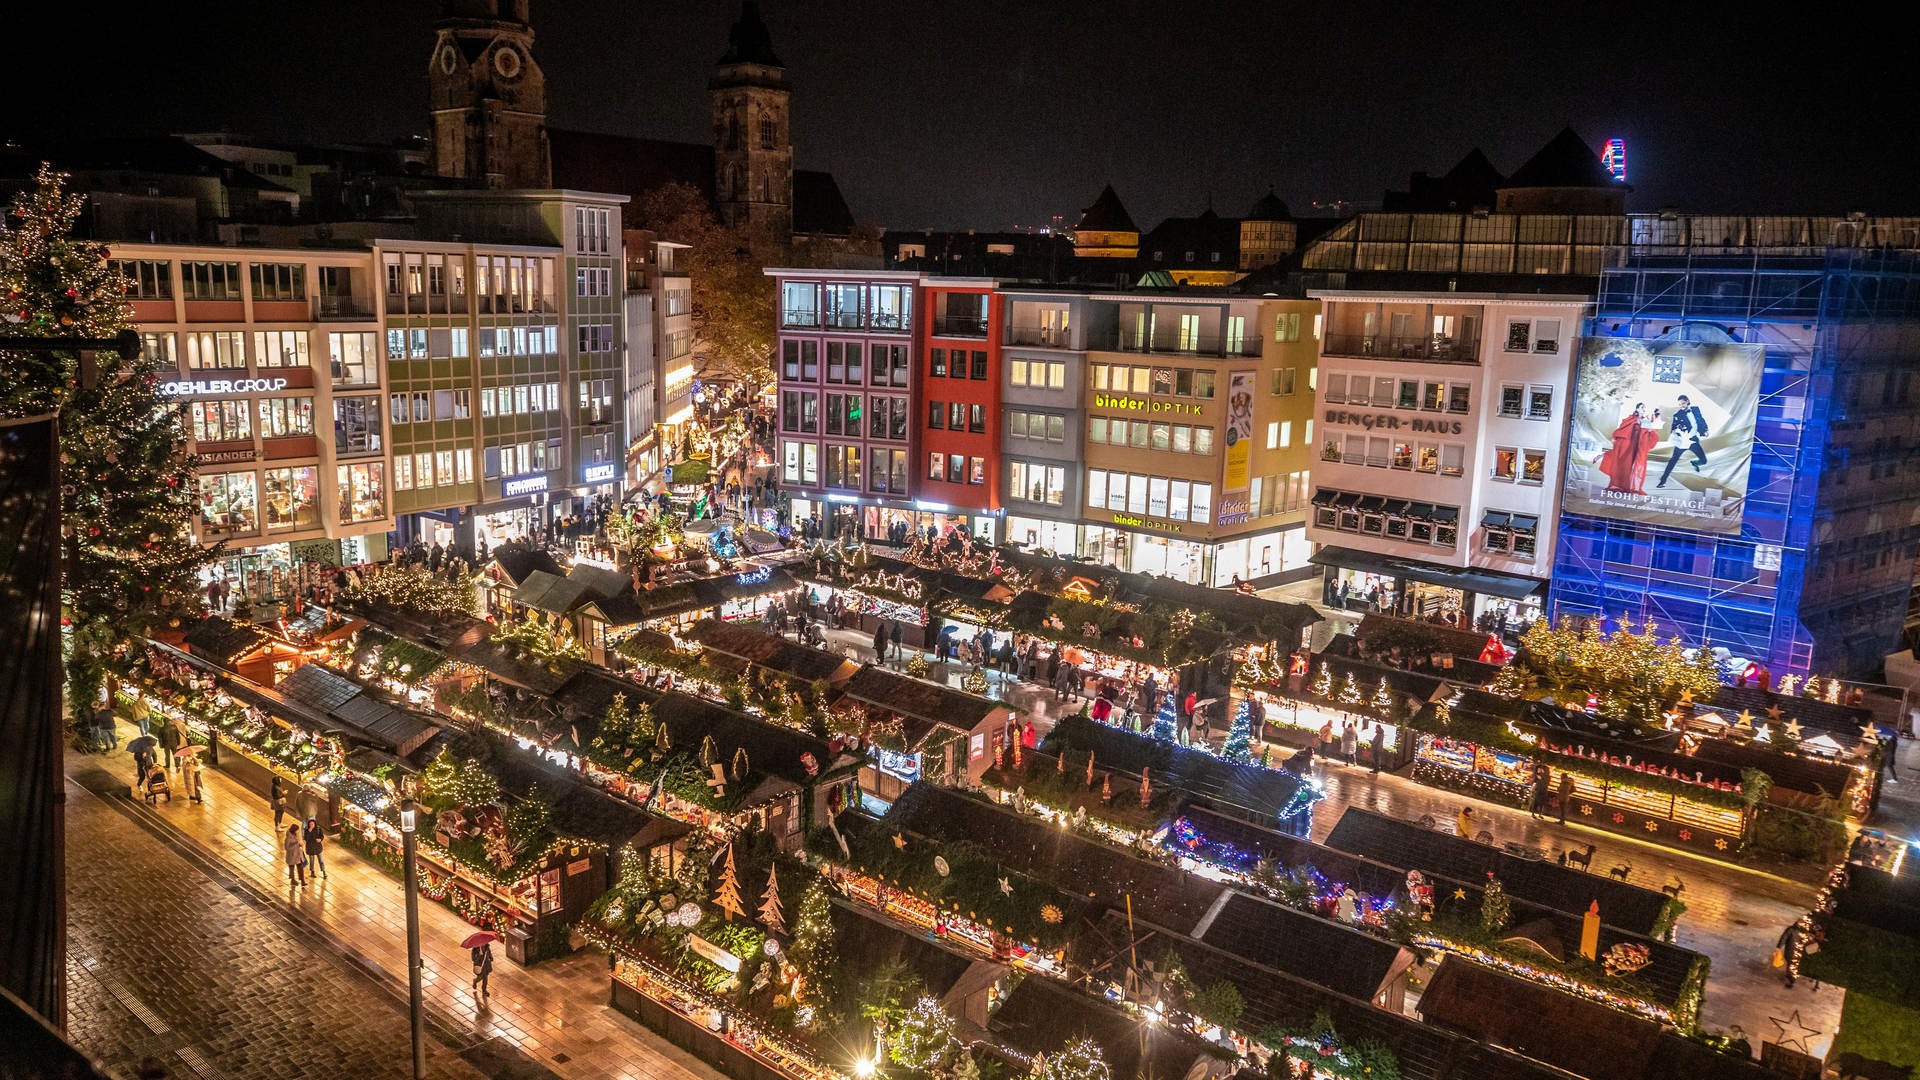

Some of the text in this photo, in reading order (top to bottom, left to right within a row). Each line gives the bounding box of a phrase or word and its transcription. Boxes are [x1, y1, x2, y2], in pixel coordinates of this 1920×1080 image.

[1095, 394, 1202, 416] binder OPTIK
[1325, 410, 1462, 435] BENGER-HAUS
[1600, 489, 1705, 510] FROHE FESTTAGE
[1113, 514, 1181, 533] binder OPTIK
